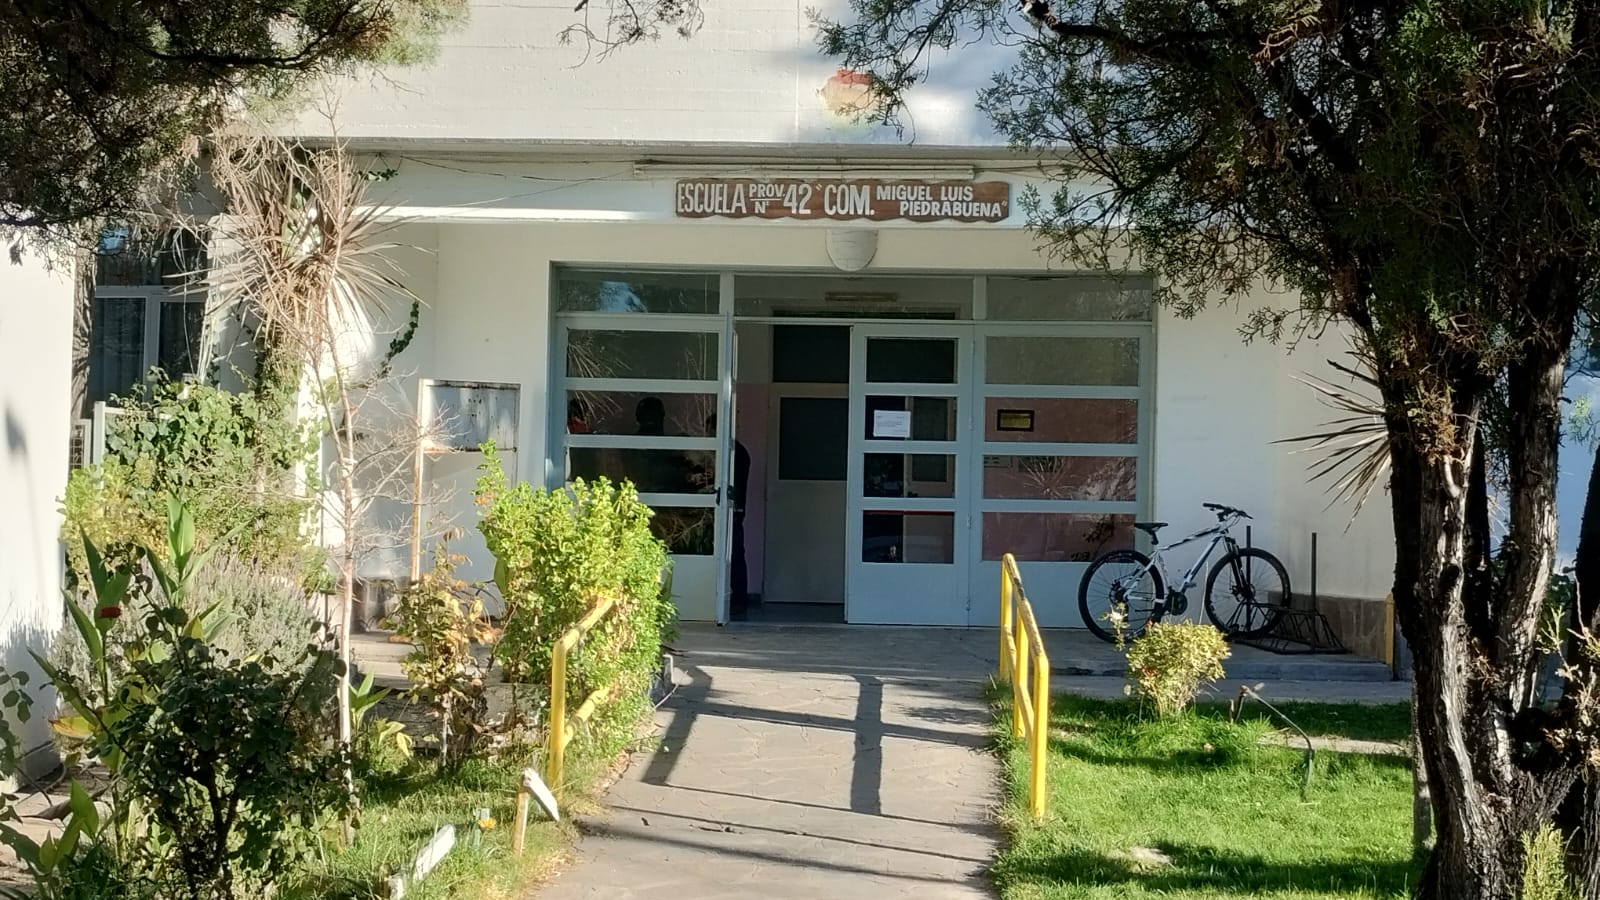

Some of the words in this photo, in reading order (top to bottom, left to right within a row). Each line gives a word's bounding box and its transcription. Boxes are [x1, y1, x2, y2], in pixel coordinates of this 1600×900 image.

[677, 183, 747, 214] ESCUELA
[748, 184, 786, 198] PROV.
[783, 183, 812, 214] 42
[815, 184, 875, 215] "COM.
[876, 185, 933, 201] MIGUEL
[940, 186, 973, 201] LUIS
[900, 200, 1007, 217] PIEDRABUENA"
